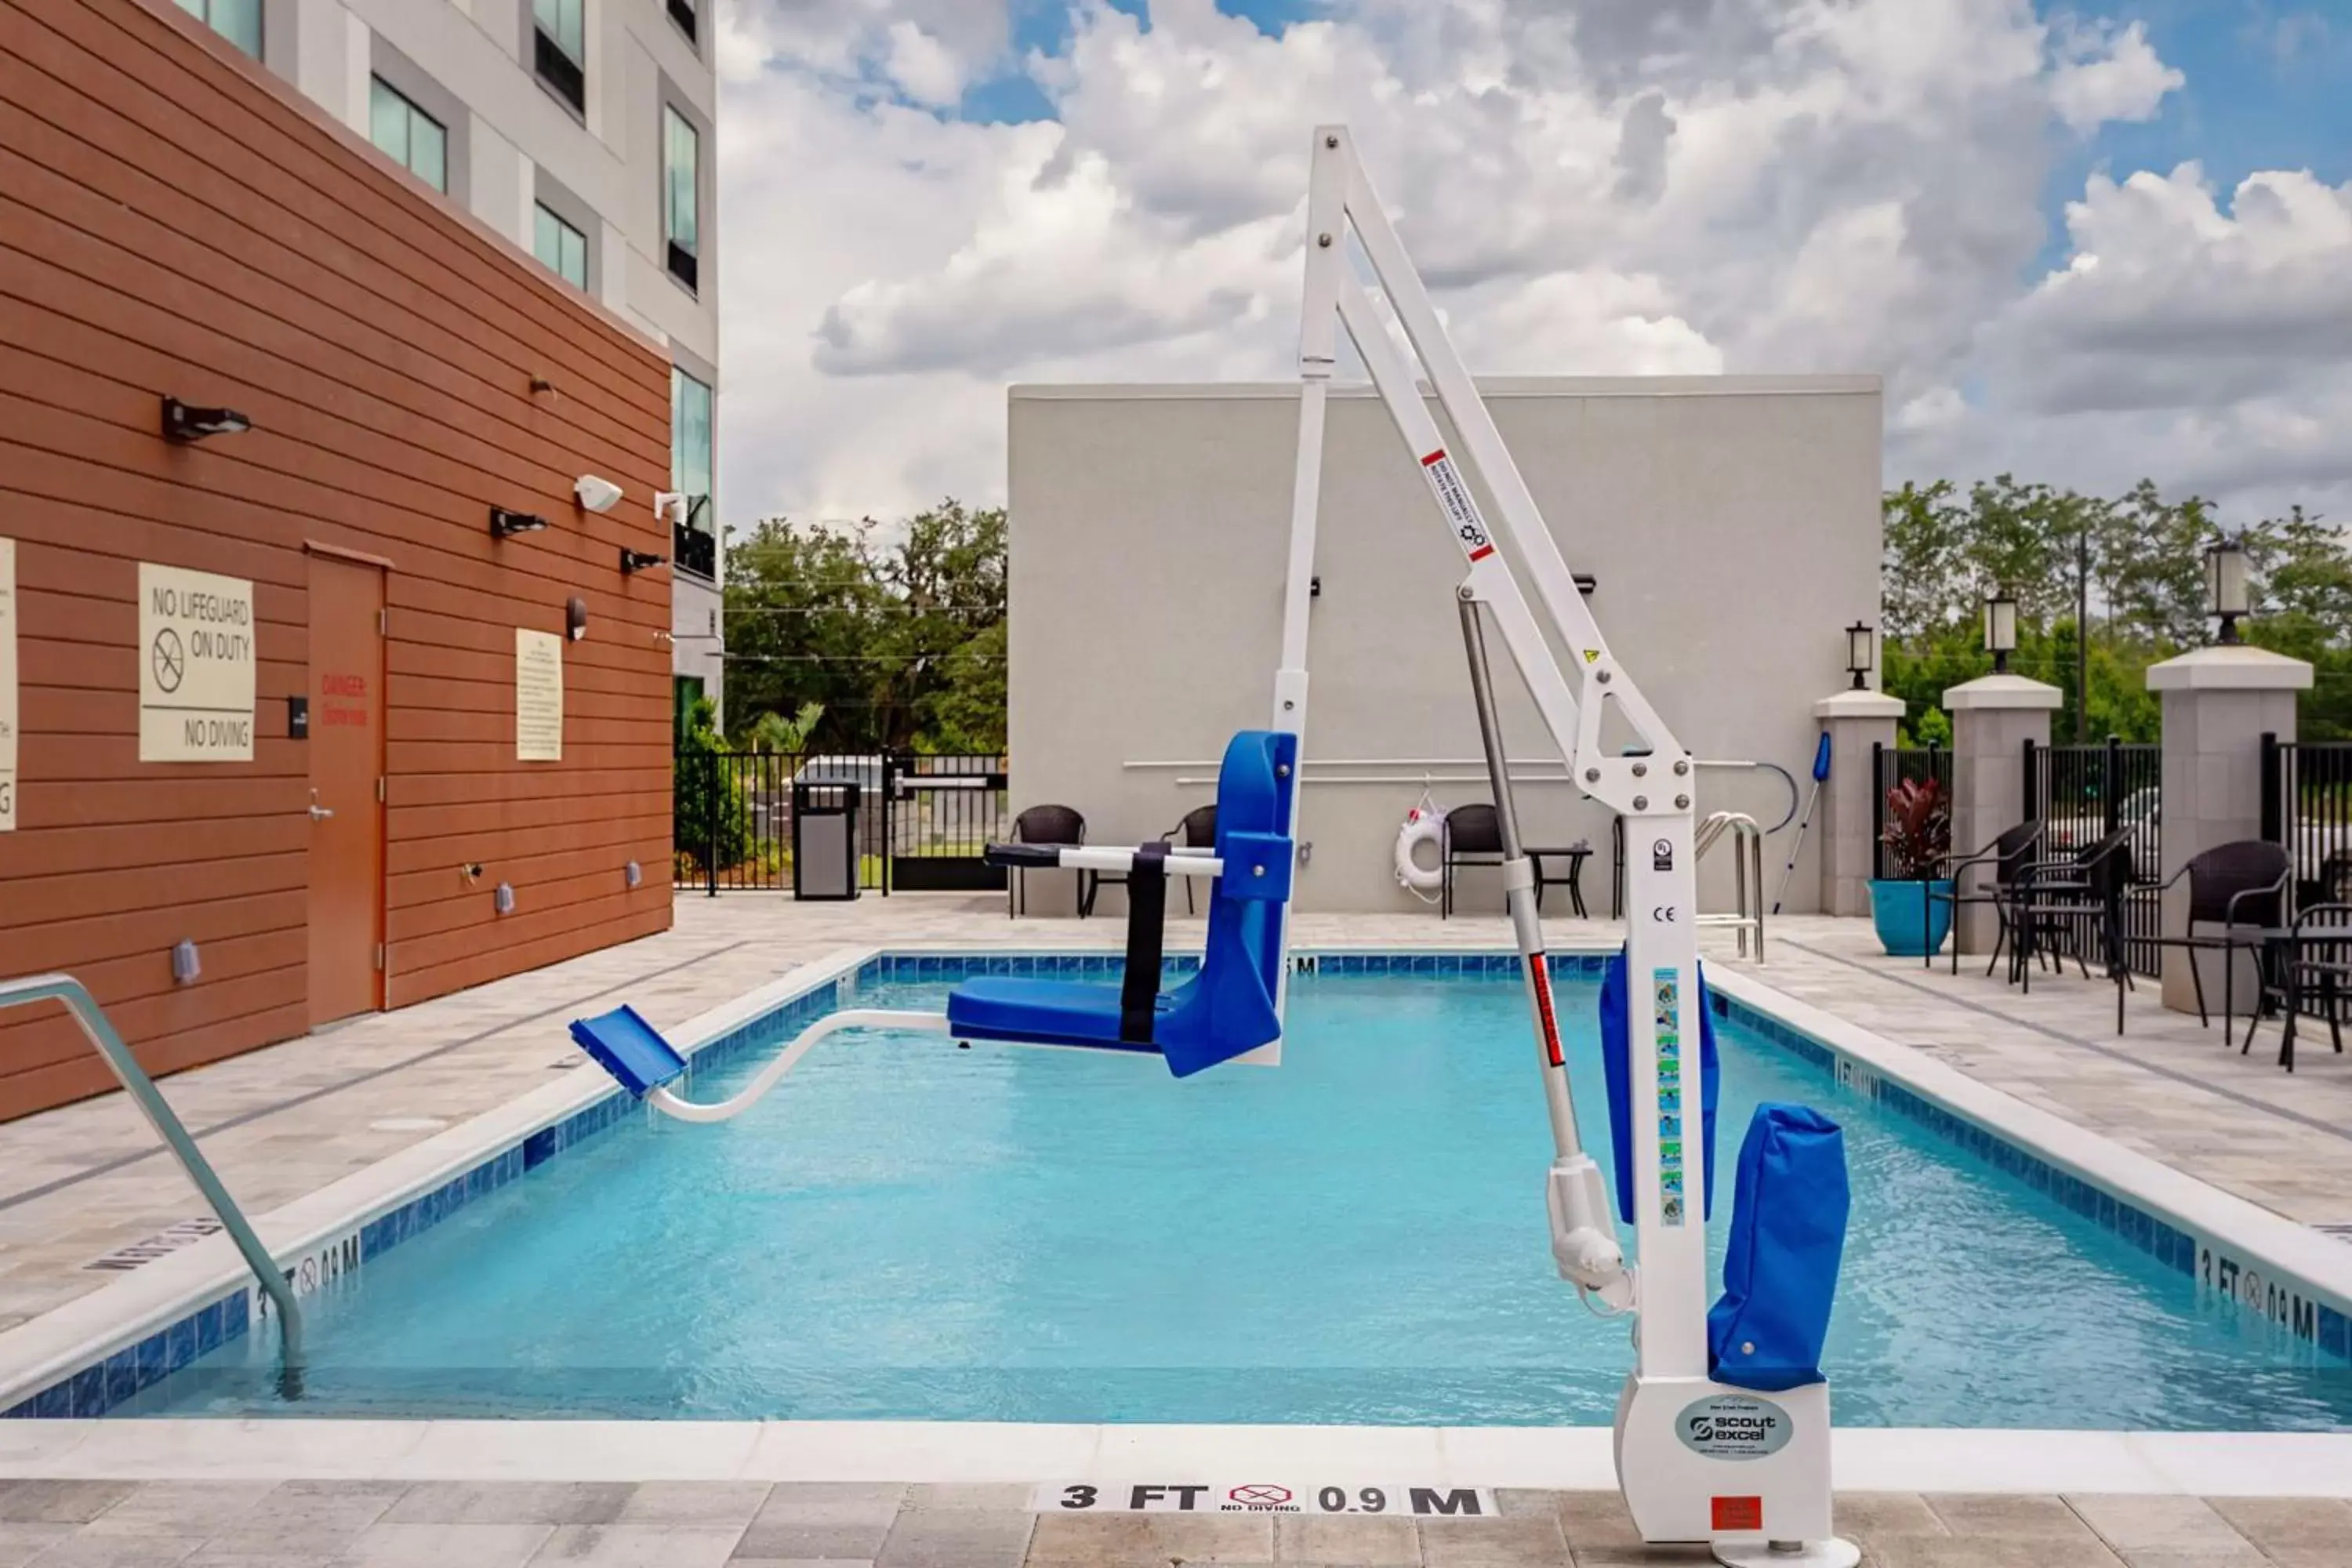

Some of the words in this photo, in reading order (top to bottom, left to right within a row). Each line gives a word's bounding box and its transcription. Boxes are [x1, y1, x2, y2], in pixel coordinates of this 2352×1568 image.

[152, 587, 176, 617] NO
[181, 591, 249, 626] LIFEGUARD
[191, 630, 212, 658] ON
[217, 632, 249, 660] DUTY
[185, 719, 205, 747] NO
[209, 719, 249, 748] DIVING
[1653, 906, 1675, 922] CE
[2294, 1294, 2313, 1343] M
[1715, 1416, 1776, 1428] scout
[1715, 1428, 1765, 1440] excel
[1061, 1485, 1098, 1509] 3
[1130, 1486, 1209, 1510] FT
[1318, 1486, 1386, 1513] 0.9
[1410, 1488, 1482, 1515] M
